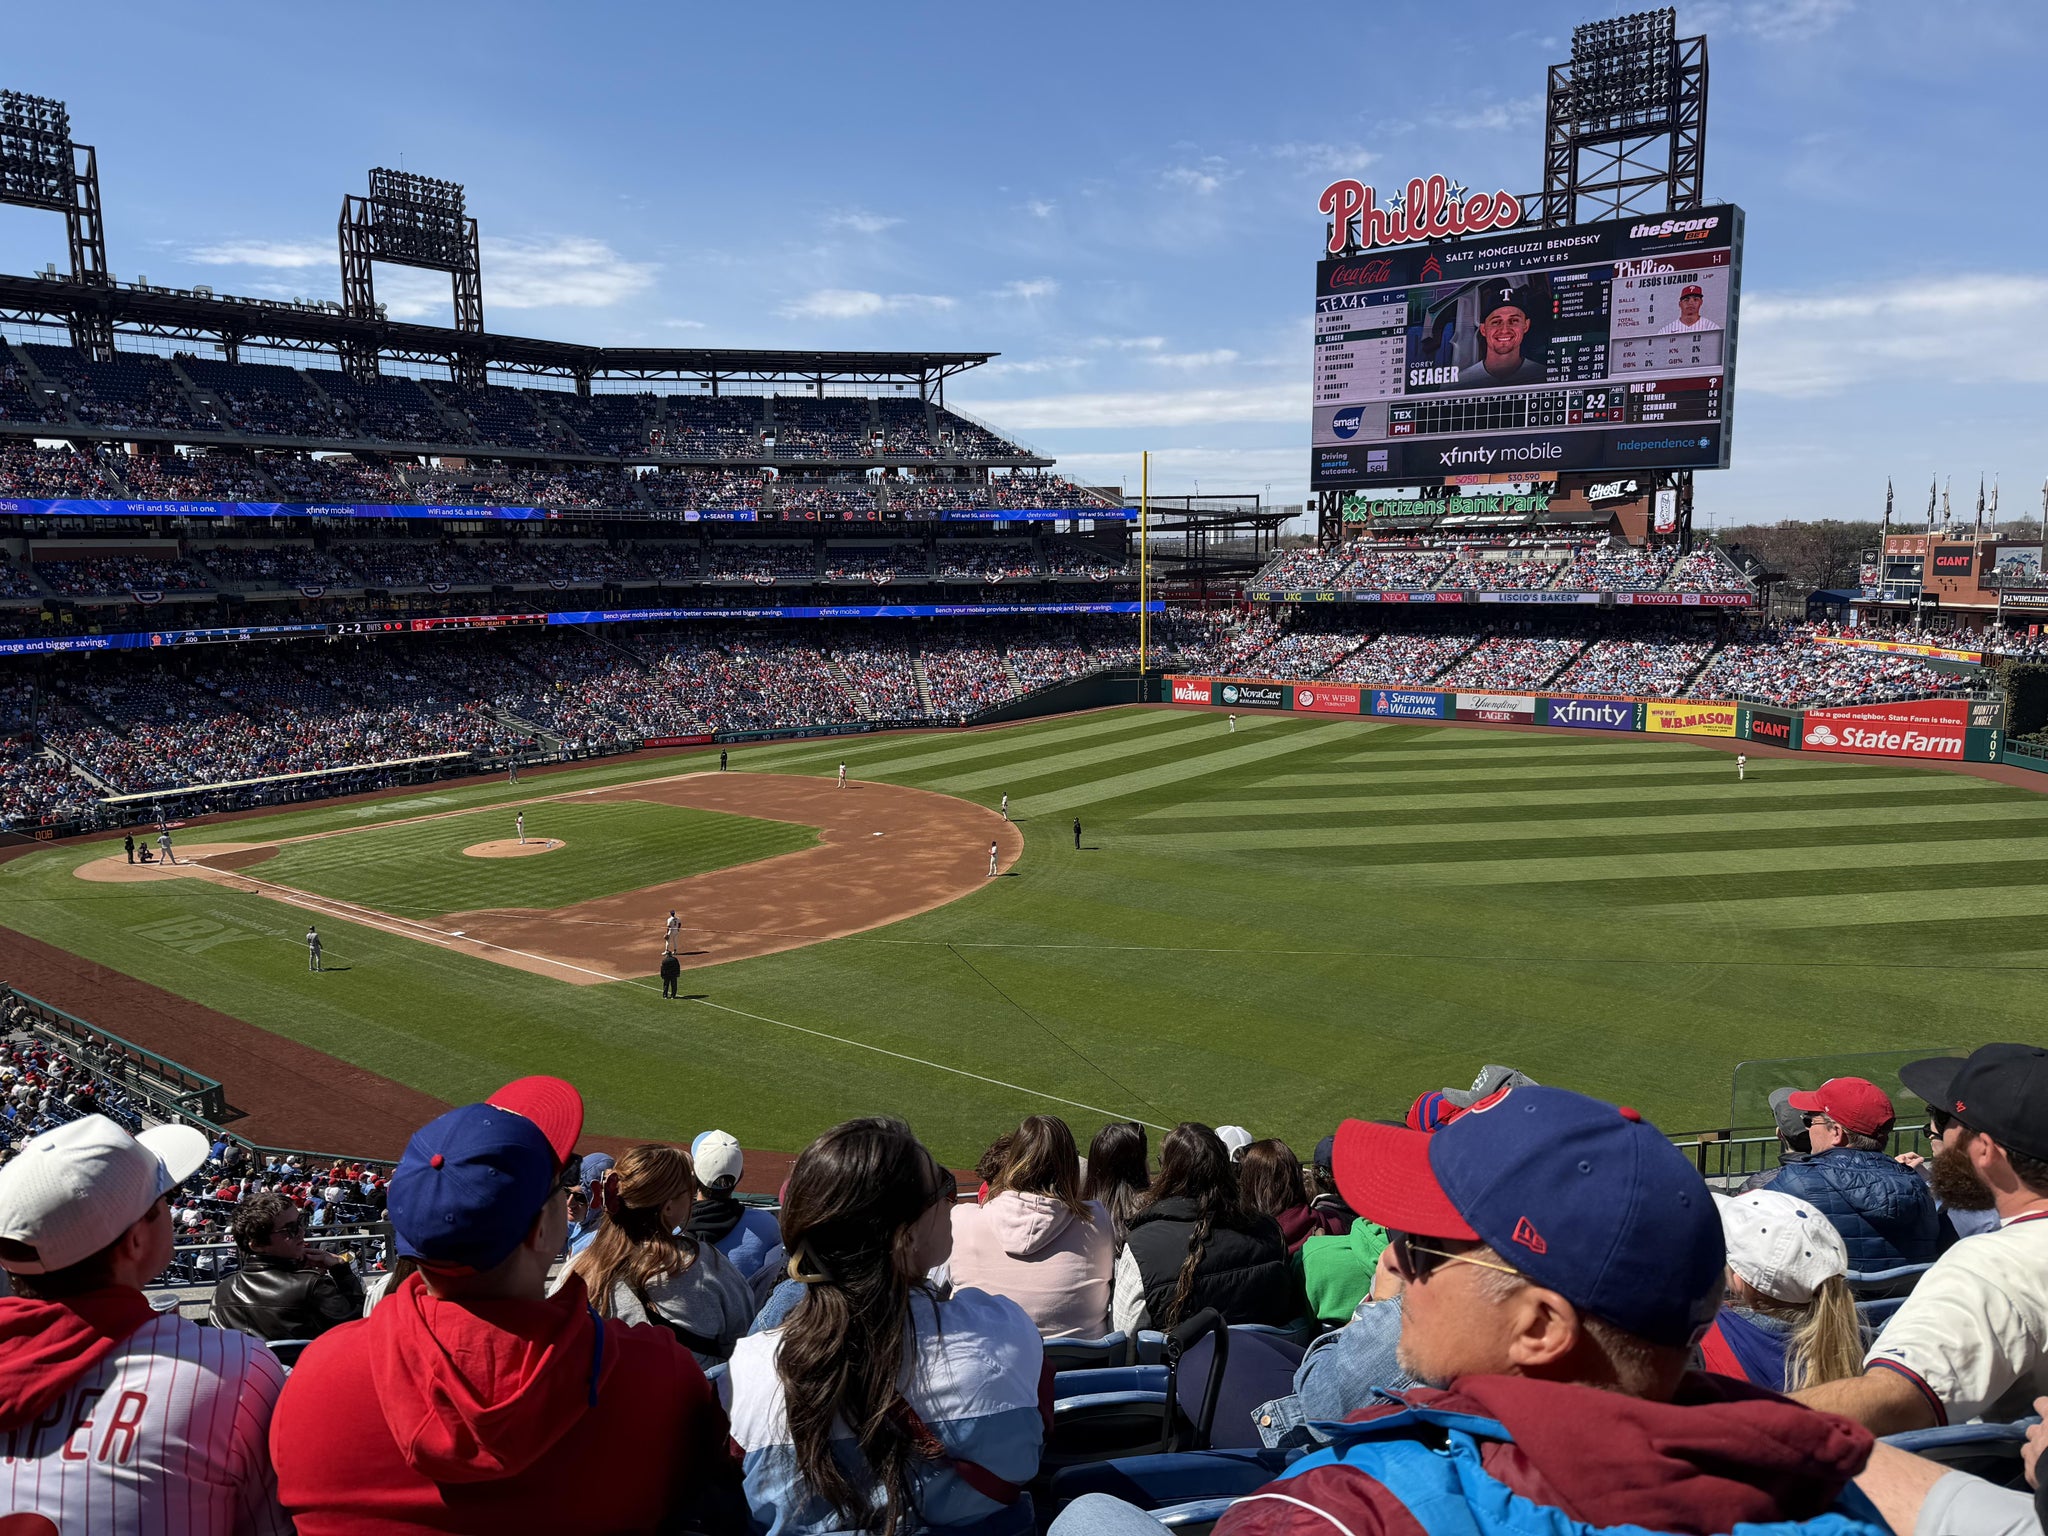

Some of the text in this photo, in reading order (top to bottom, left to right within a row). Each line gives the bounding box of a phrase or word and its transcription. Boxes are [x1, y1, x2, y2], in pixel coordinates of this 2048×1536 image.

[1318, 174, 1520, 253] Phillies
[1629, 217, 1719, 238] theScore
[1446, 235, 1601, 263] SALTZ MONGELUZZI BENDESKY
[1474, 253, 1569, 271] INJURY LAWYERS
[1614, 259, 1675, 278] Phillies
[1638, 276, 1662, 289] JESÚS
[1663, 273, 1698, 286] LUZARDO
[1320, 295, 1367, 312] TEXAS
[1325, 334, 1344, 343] SEAGER
[1410, 361, 1434, 369] COREY
[1410, 367, 1460, 387] SEAGER
[1630, 382, 1656, 394] DUE UP
[1586, 394, 1605, 410] 2-2
[1643, 393, 1665, 401] TURNER
[1393, 411, 1412, 420] TEX
[1642, 413, 1664, 421] HARPER
[1333, 417, 1360, 428] smart
[1394, 425, 1411, 434] PHI
[1617, 437, 1695, 451] Independence
[1321, 452, 1348, 463] Driving
[1439, 443, 1563, 467] xfinity mobile
[1320, 468, 1358, 476] outcomes.
[1508, 473, 1540, 483] $30,590
[1588, 480, 1629, 502] GHOST
[0, 500, 19, 511] bile
[127, 504, 146, 513] WiFi
[147, 504, 163, 513] and
[164, 504, 178, 514] 5G,
[180, 504, 190, 513] all
[191, 504, 199, 513] in
[1370, 491, 1550, 517] Citizens Bank Park
[306, 506, 355, 515] xfinity mobile
[427, 508, 441, 516] WiFi
[442, 508, 454, 516] and
[1937, 556, 1970, 567] GIANT
[1252, 592, 1271, 601] UKG
[1284, 592, 1302, 601] UKG
[1316, 592, 1335, 601] UKG
[1383, 593, 1408, 601] NECA
[1437, 593, 1463, 601] NECA
[1499, 594, 1580, 602] LISCIO'S BAKERY
[1636, 594, 1679, 603] TOYOTA
[1704, 595, 1748, 604] TOYOTA
[632, 611, 648, 619] mobile
[684, 610, 702, 618] better
[703, 610, 730, 618] coverage
[743, 609, 761, 618] bigger
[819, 608, 839, 617] xfinity
[986, 606, 1010, 615] provider
[1038, 605, 1062, 614] coverage
[1075, 605, 1092, 614] bigger
[0, 638, 110, 655] erage and bigger savings.
[1174, 687, 1210, 702] Wawa
[1239, 687, 1281, 699] NovaCare
[1316, 693, 1356, 703] F.W. WEBB
[1391, 693, 1436, 705] SHERWIN
[1470, 696, 1521, 711] Yuengling
[1552, 701, 1628, 726] xfinity
[1972, 704, 2000, 716] MONTY'S
[1478, 712, 1511, 721] LAGER
[1635, 703, 1643, 730] 374
[1809, 710, 1825, 718] Like
[1832, 712, 1851, 720] good
[1852, 713, 1887, 721] neighbor,
[1888, 714, 1908, 722] State
[1939, 717, 1963, 725] there.
[1972, 716, 1994, 727] ANGLE
[1752, 720, 1791, 738] GIANT
[1840, 727, 1962, 754] State Farm
[1989, 730, 1998, 761] 409
[4, 1388, 150, 1466] PER
